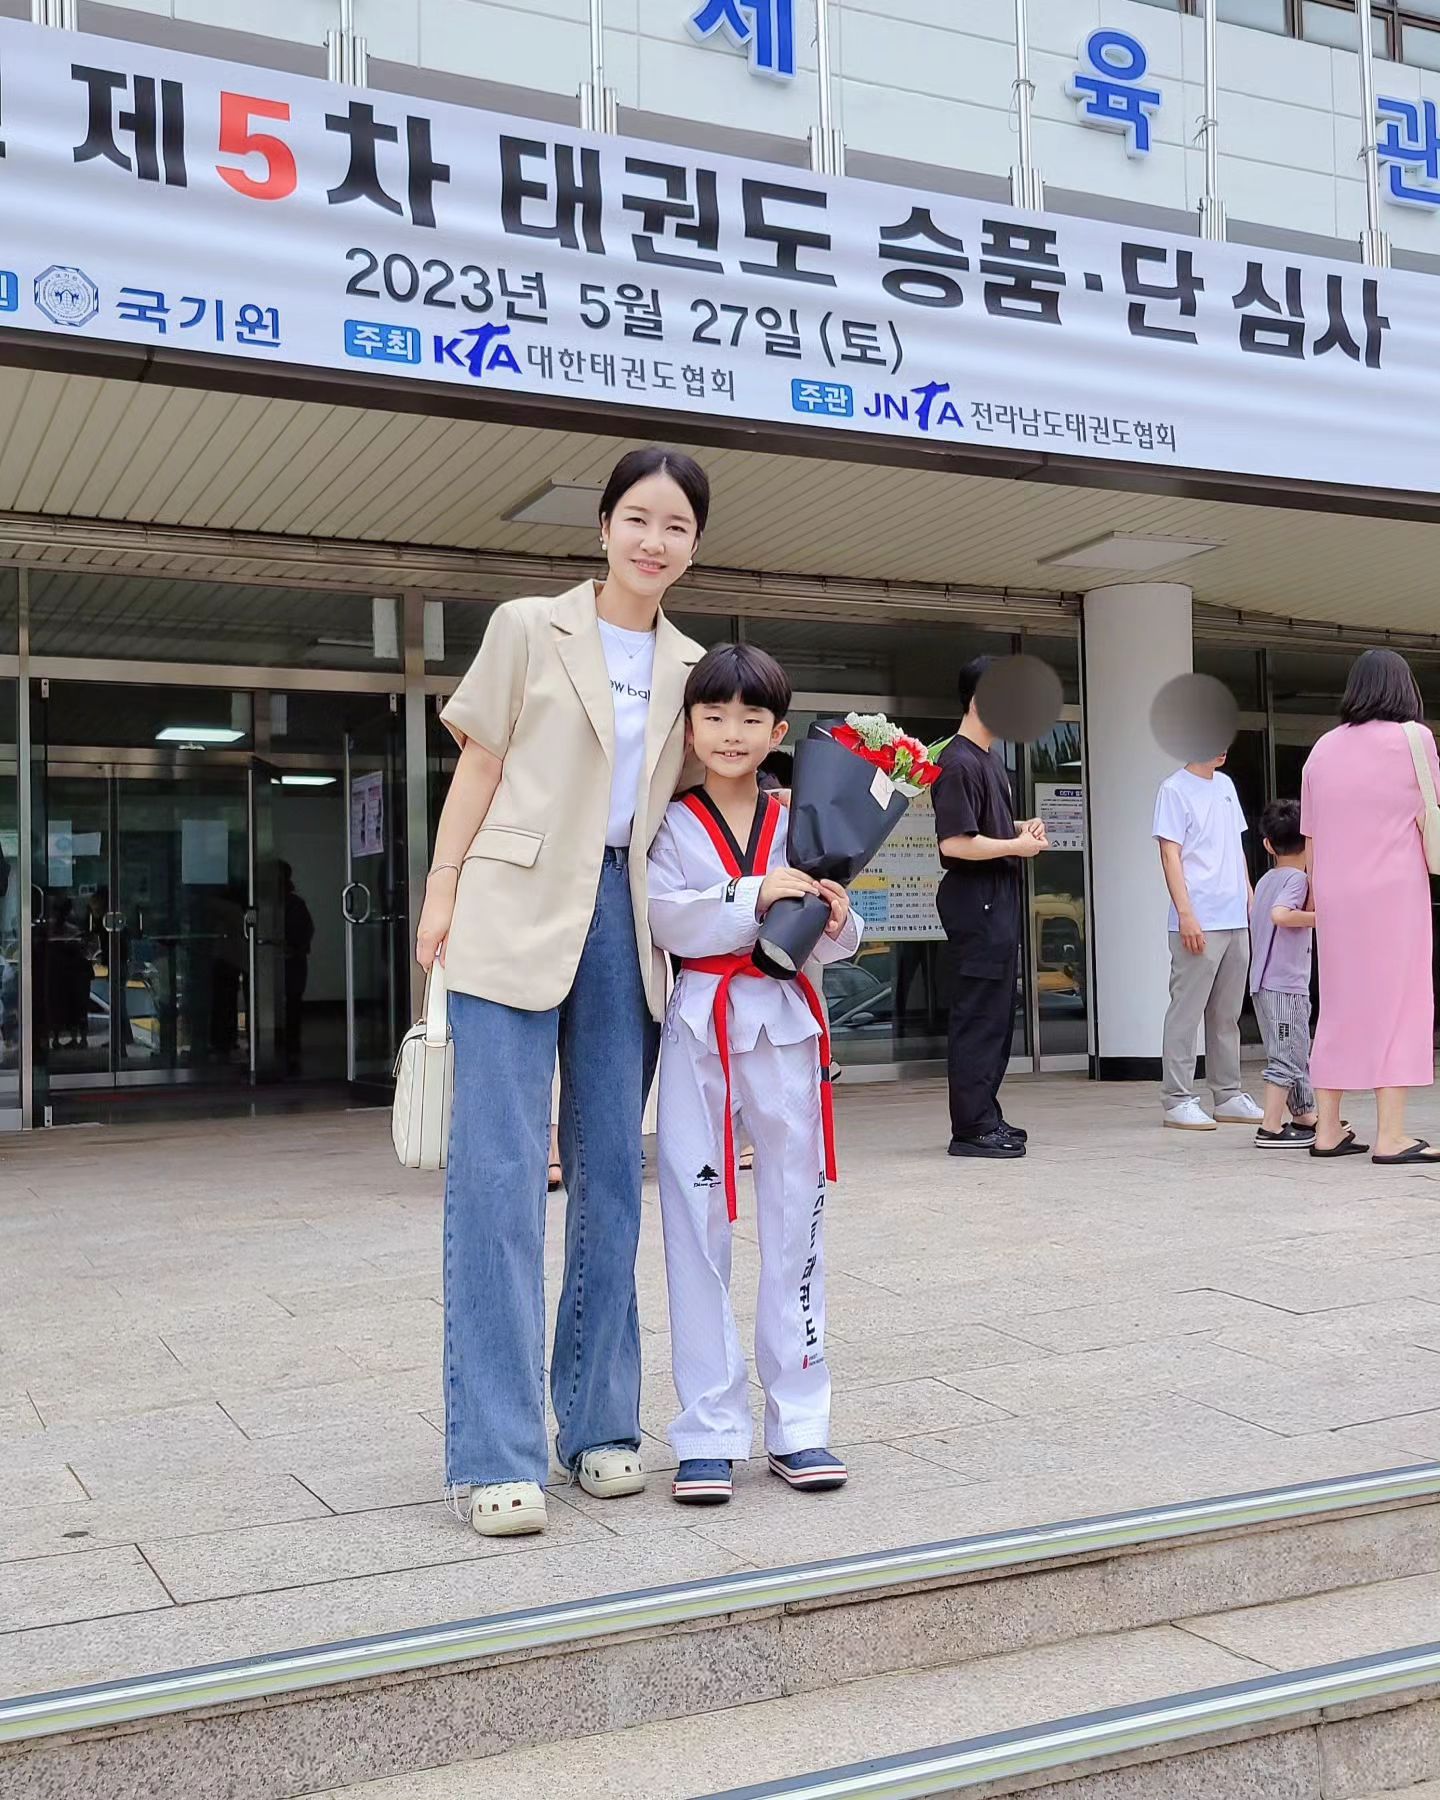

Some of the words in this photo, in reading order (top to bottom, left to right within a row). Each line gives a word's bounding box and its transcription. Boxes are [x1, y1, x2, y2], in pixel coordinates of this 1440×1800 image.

[1072, 30, 1161, 151] 육
[70, 62, 451, 229] 제5차
[499, 133, 838, 288] 태권도
[878, 206, 1205, 345] 승품·단
[1232, 260, 1393, 369] 심사
[116, 287, 282, 349] 국기원
[345, 247, 548, 325] 2023년
[579, 282, 664, 341] 5월
[690, 298, 803, 361] 27일
[818, 310, 903, 375] (토)
[352, 324, 414, 362] 주최
[433, 321, 523, 378] KTA
[526, 344, 736, 402] 대한태권도협회
[798, 382, 849, 415] 주관
[970, 401, 1177, 453] 전라남도태권도협회
